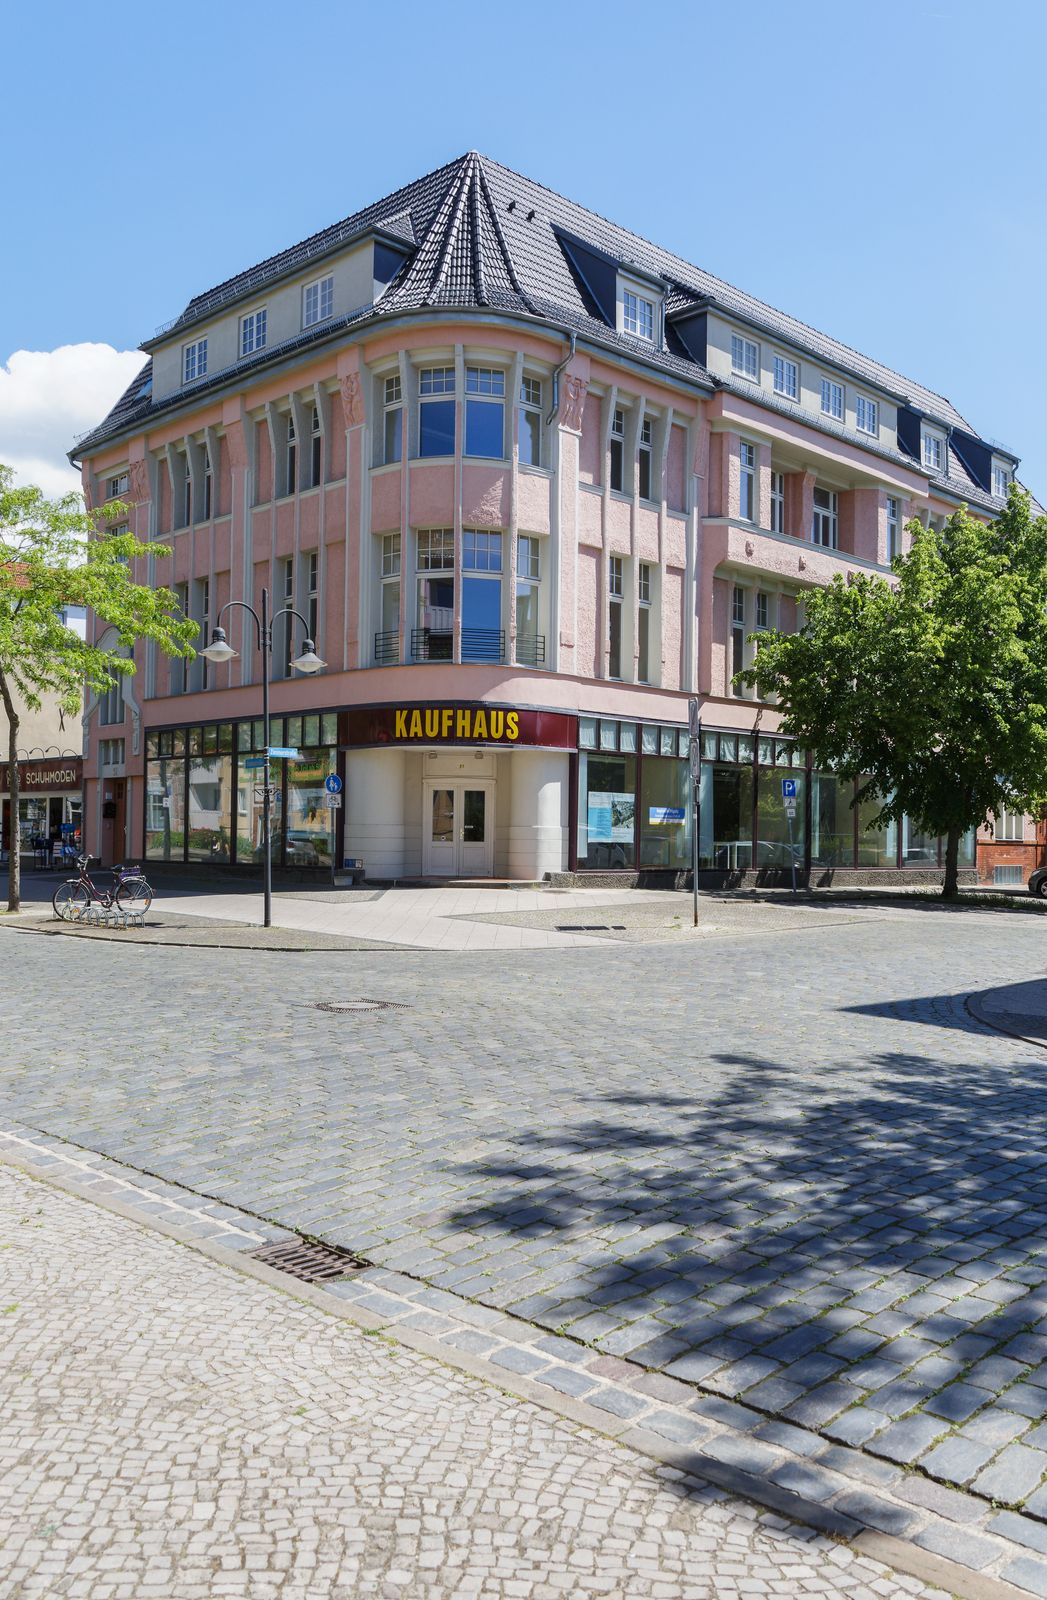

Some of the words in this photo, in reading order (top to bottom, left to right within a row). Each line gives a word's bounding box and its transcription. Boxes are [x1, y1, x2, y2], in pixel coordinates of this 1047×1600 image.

[395, 709, 519, 740] KAUFHAUS
[26, 770, 76, 785] SCHUHMODEN
[786, 781, 793, 795] P
